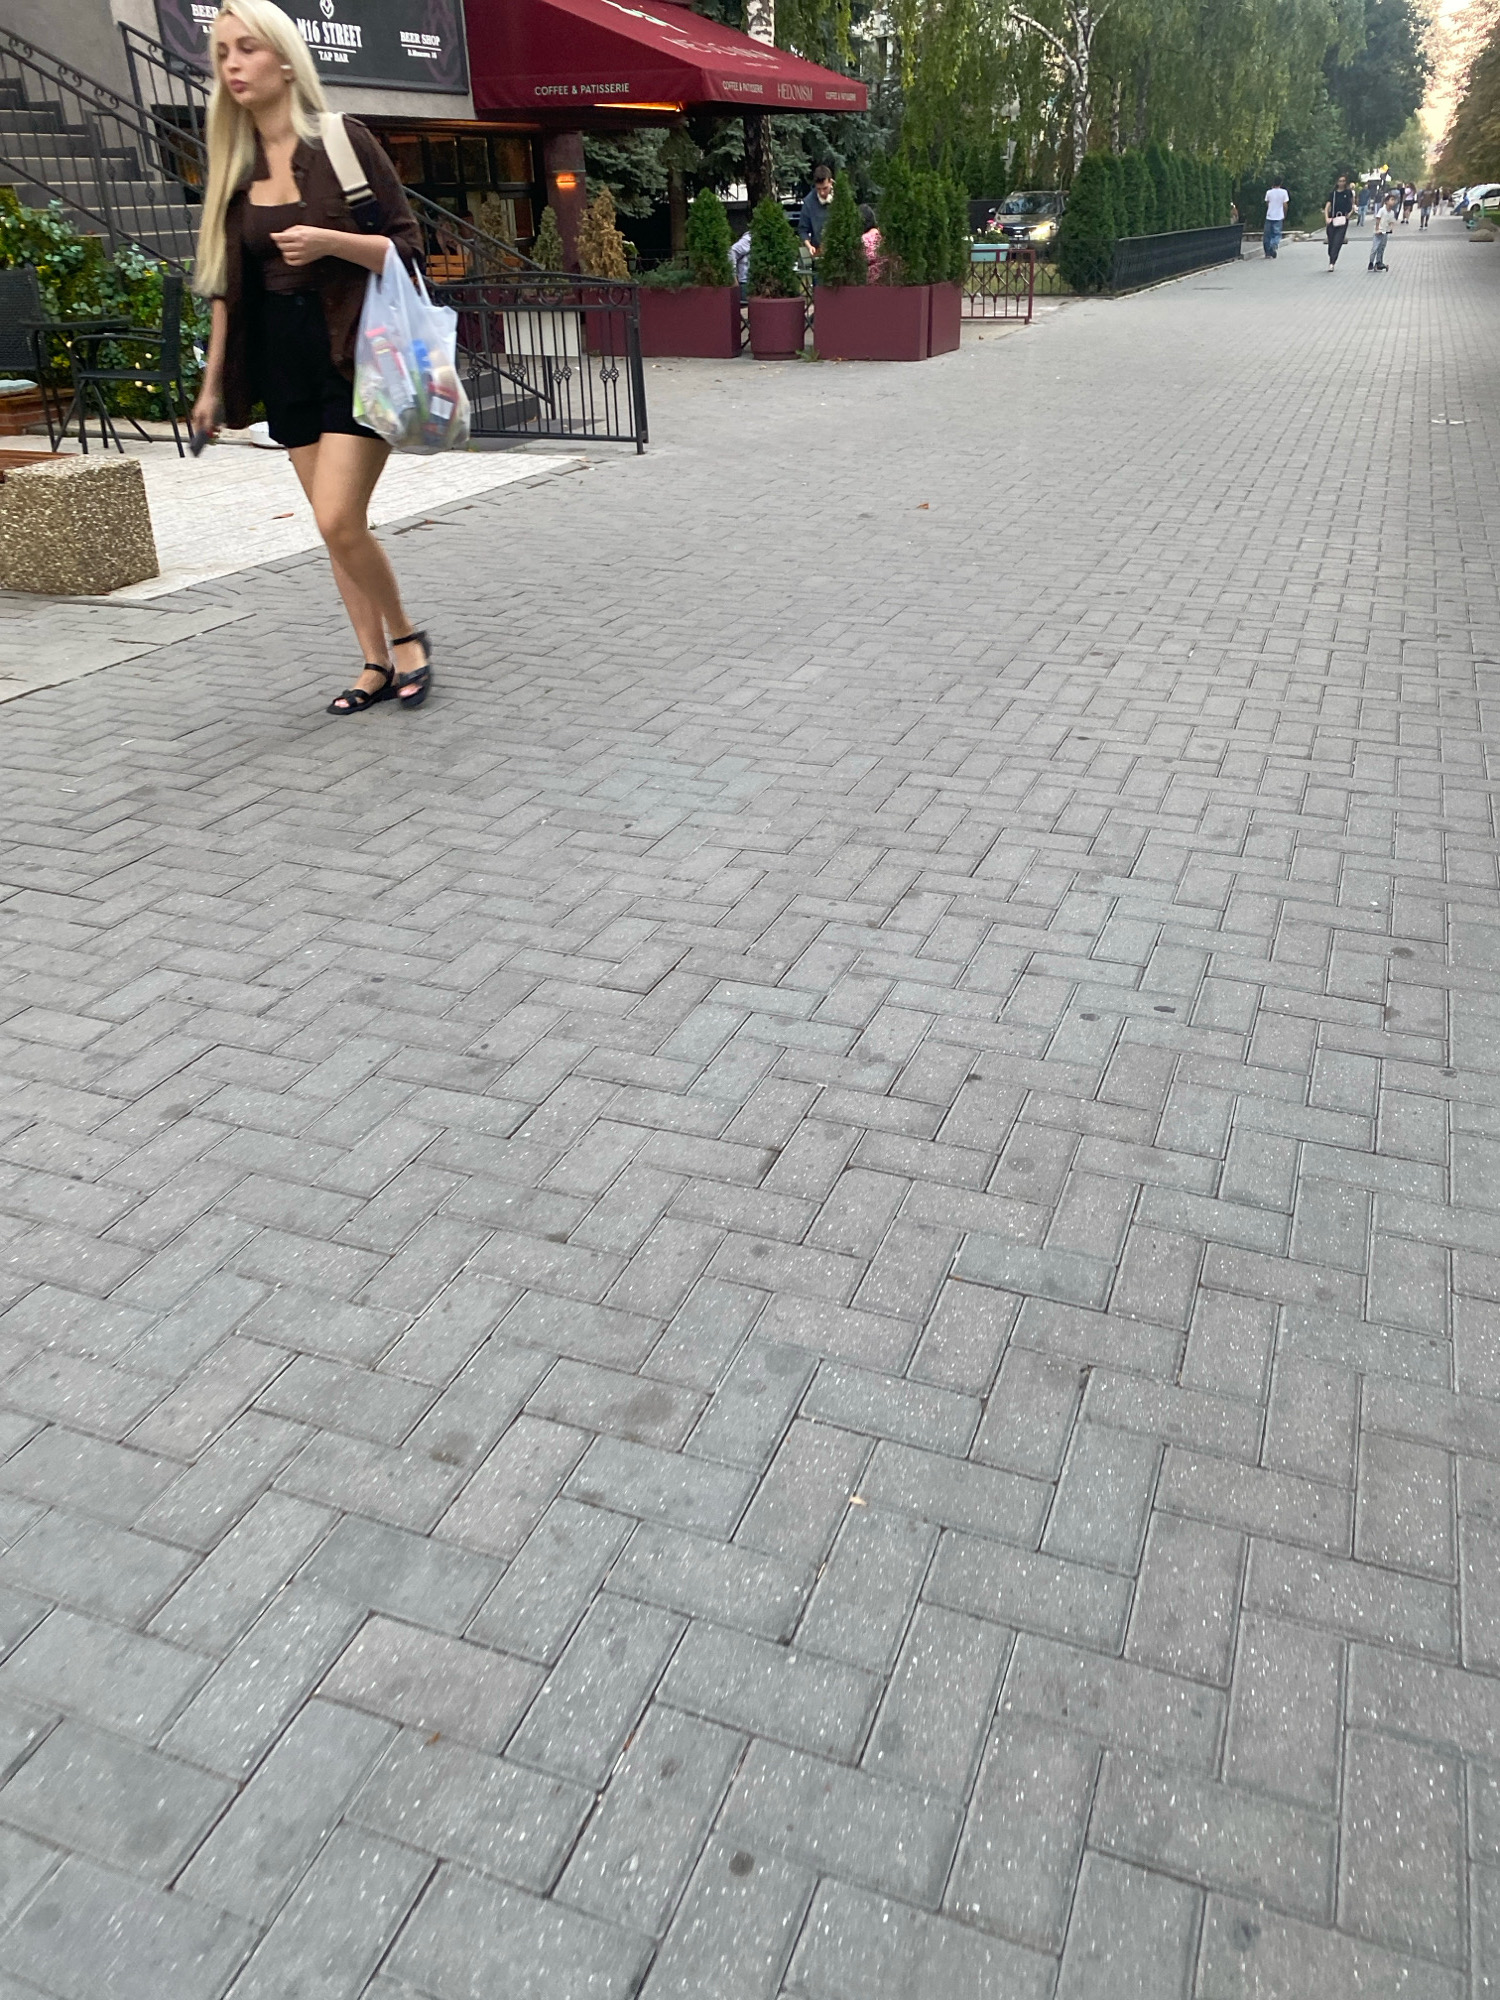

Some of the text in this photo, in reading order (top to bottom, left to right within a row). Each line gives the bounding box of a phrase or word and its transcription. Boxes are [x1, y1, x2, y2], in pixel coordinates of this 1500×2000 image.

[322, 21, 362, 48] STREET
[400, 31, 440, 46] BEER SHOP
[318, 50, 350, 63] TAP BAR
[535, 83, 630, 96] COFFEE & PATISSERIE
[722, 80, 739, 91] COFFEE
